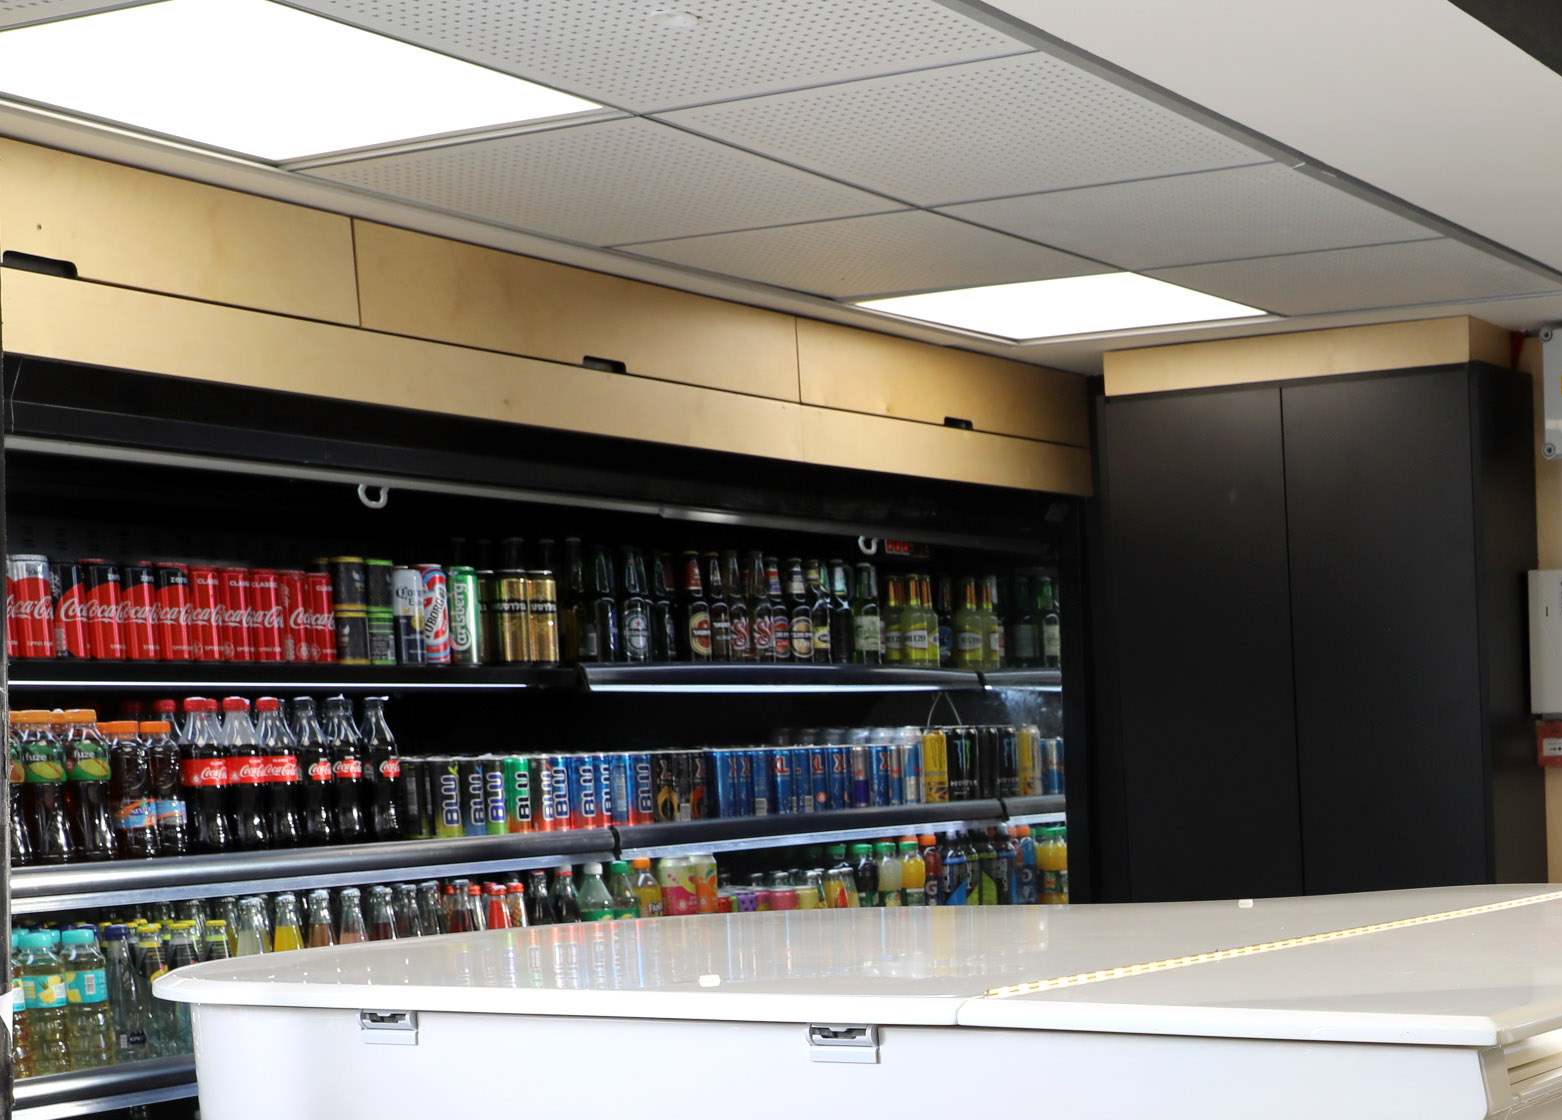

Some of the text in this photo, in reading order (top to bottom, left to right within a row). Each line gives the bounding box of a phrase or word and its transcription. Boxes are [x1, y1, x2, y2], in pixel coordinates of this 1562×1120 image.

[441, 775, 461, 827] BLU
[469, 773, 485, 825] BLU
[487, 771, 506, 823] BLU
[515, 771, 531, 821] BLU
[552, 766, 571, 819] BLU
[580, 766, 596, 817] BLU
